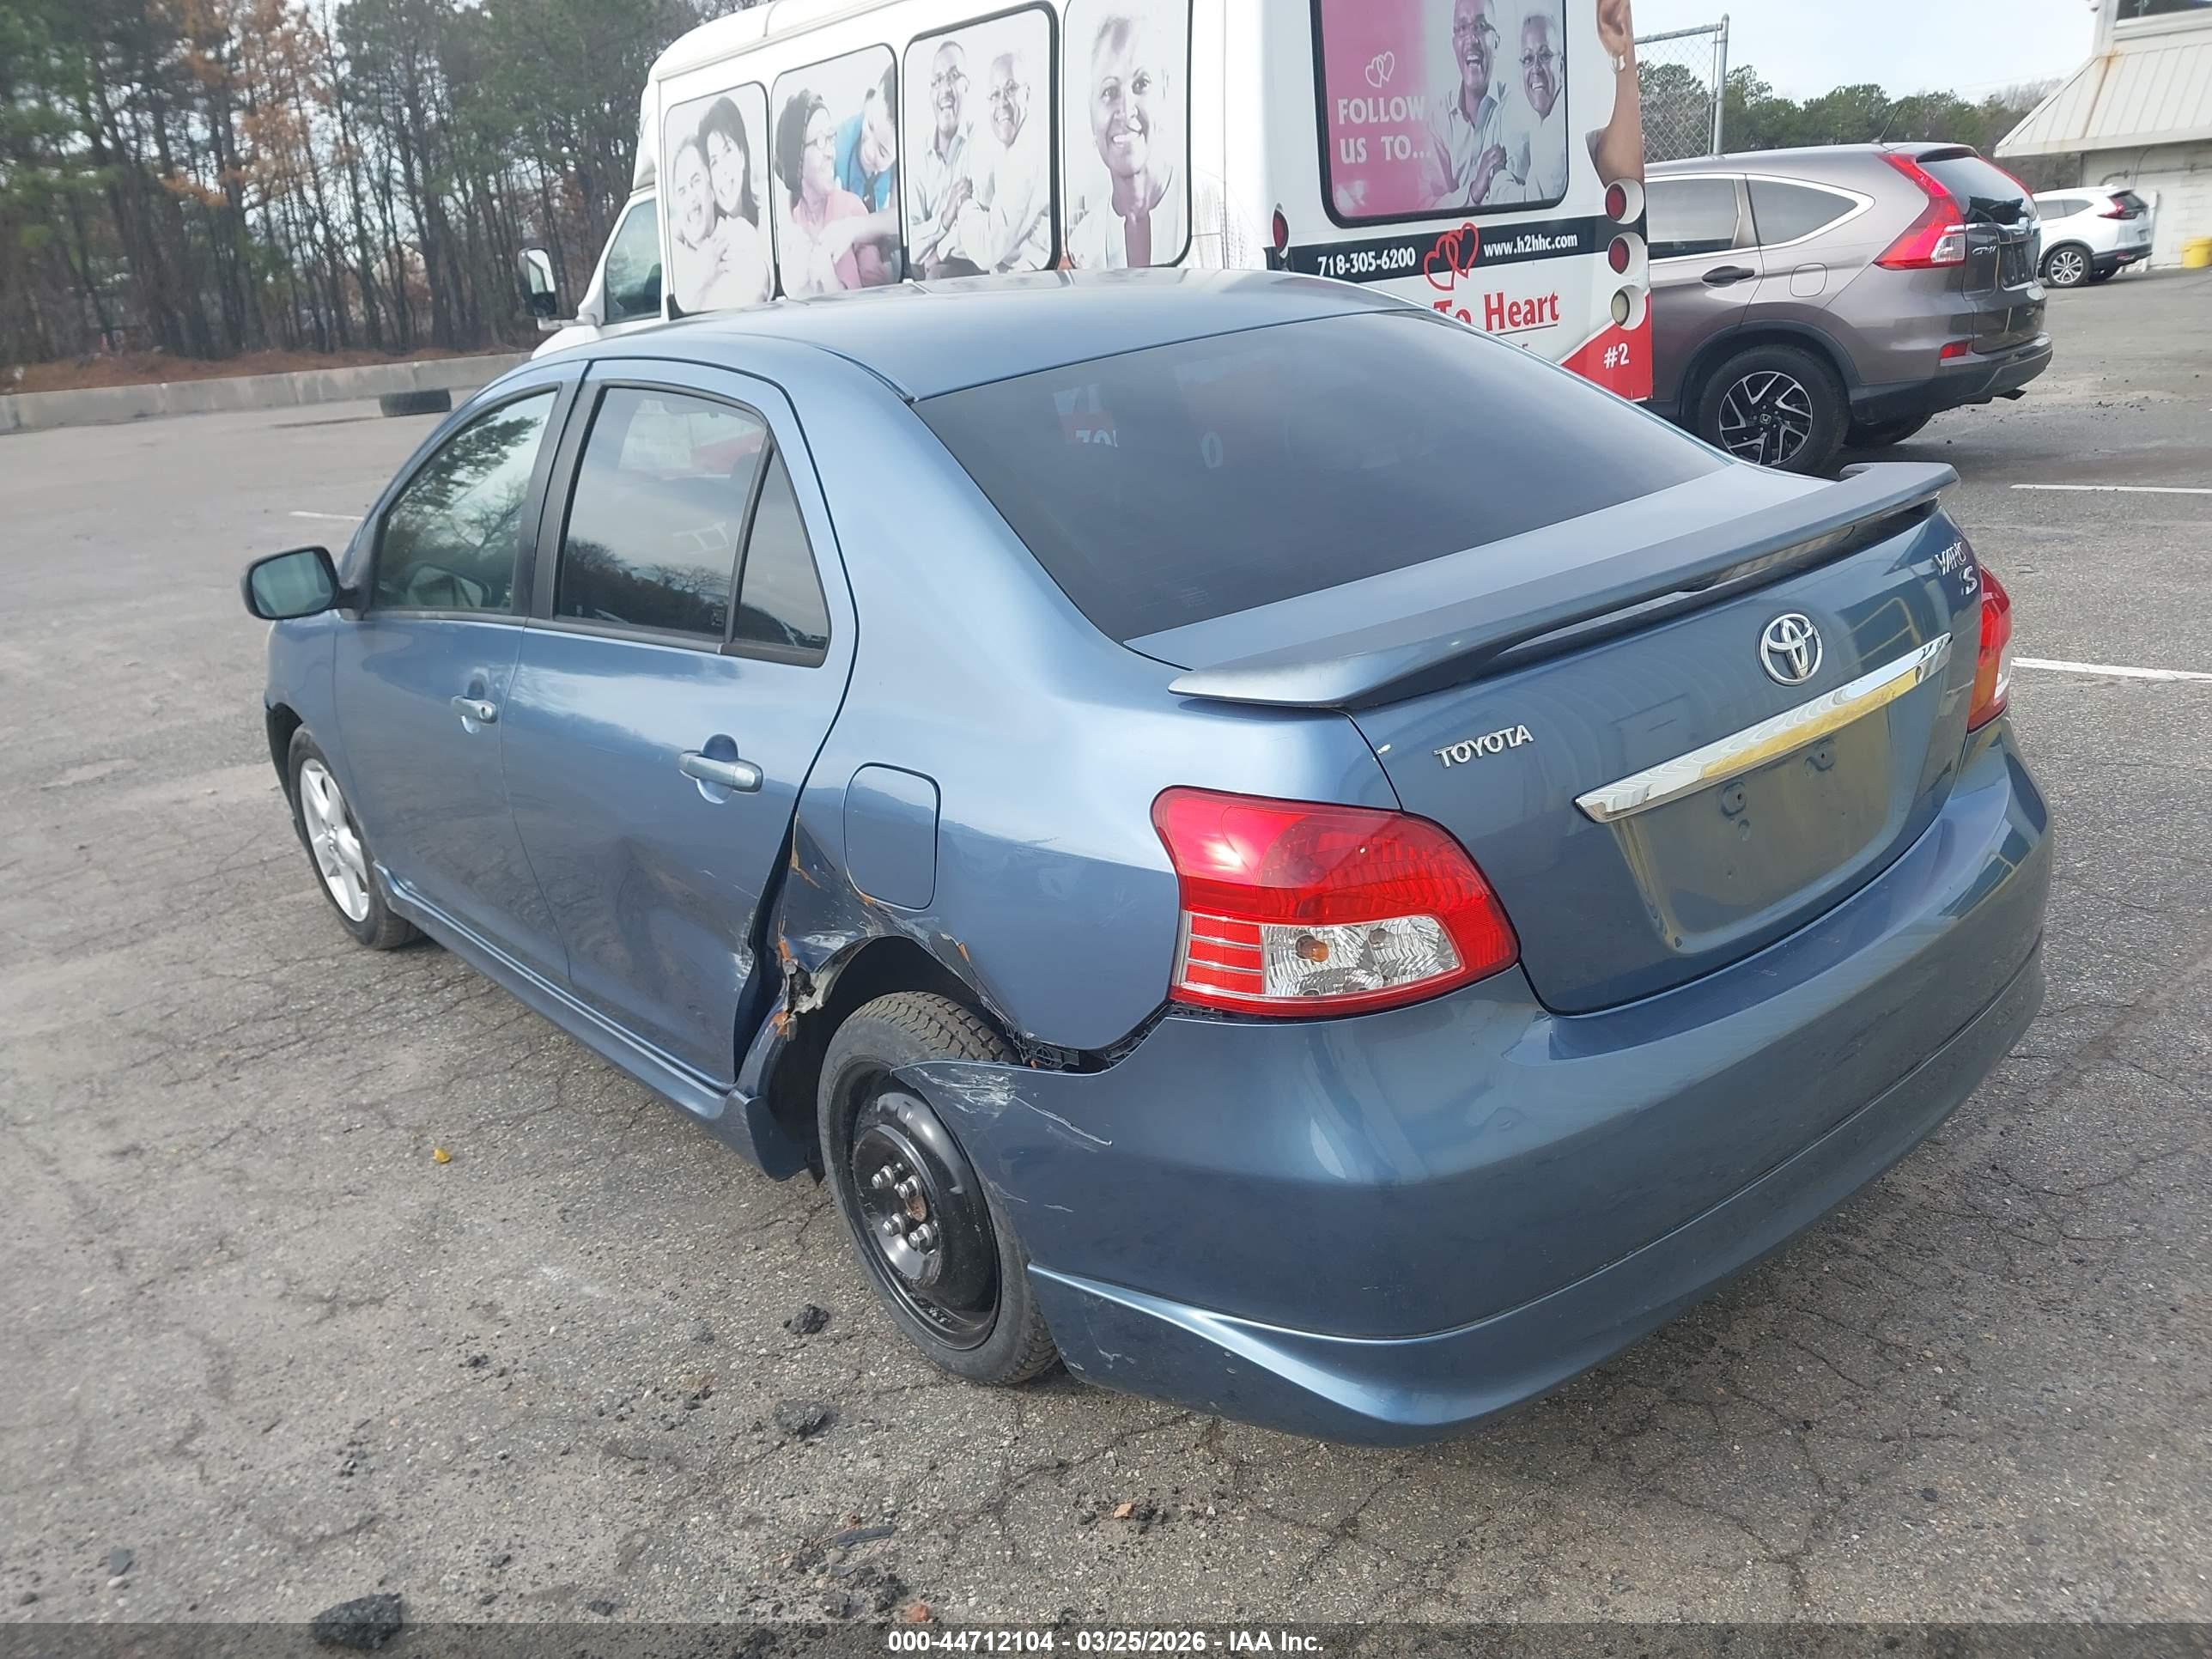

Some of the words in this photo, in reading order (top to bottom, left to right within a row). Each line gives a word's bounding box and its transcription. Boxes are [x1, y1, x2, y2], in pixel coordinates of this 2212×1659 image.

[1337, 96, 1425, 125] FOLLOW
[1340, 137, 1367, 164] US
[1381, 135, 1431, 161] TO...
[1483, 233, 1578, 258] www.h2hhc.com
[1317, 246, 1416, 276] 718-305-6200
[1484, 291, 1560, 331] Heart
[1604, 343, 1630, 369] #2
[1962, 565, 1978, 595] S
[1433, 725, 1534, 768] TOYOTA
